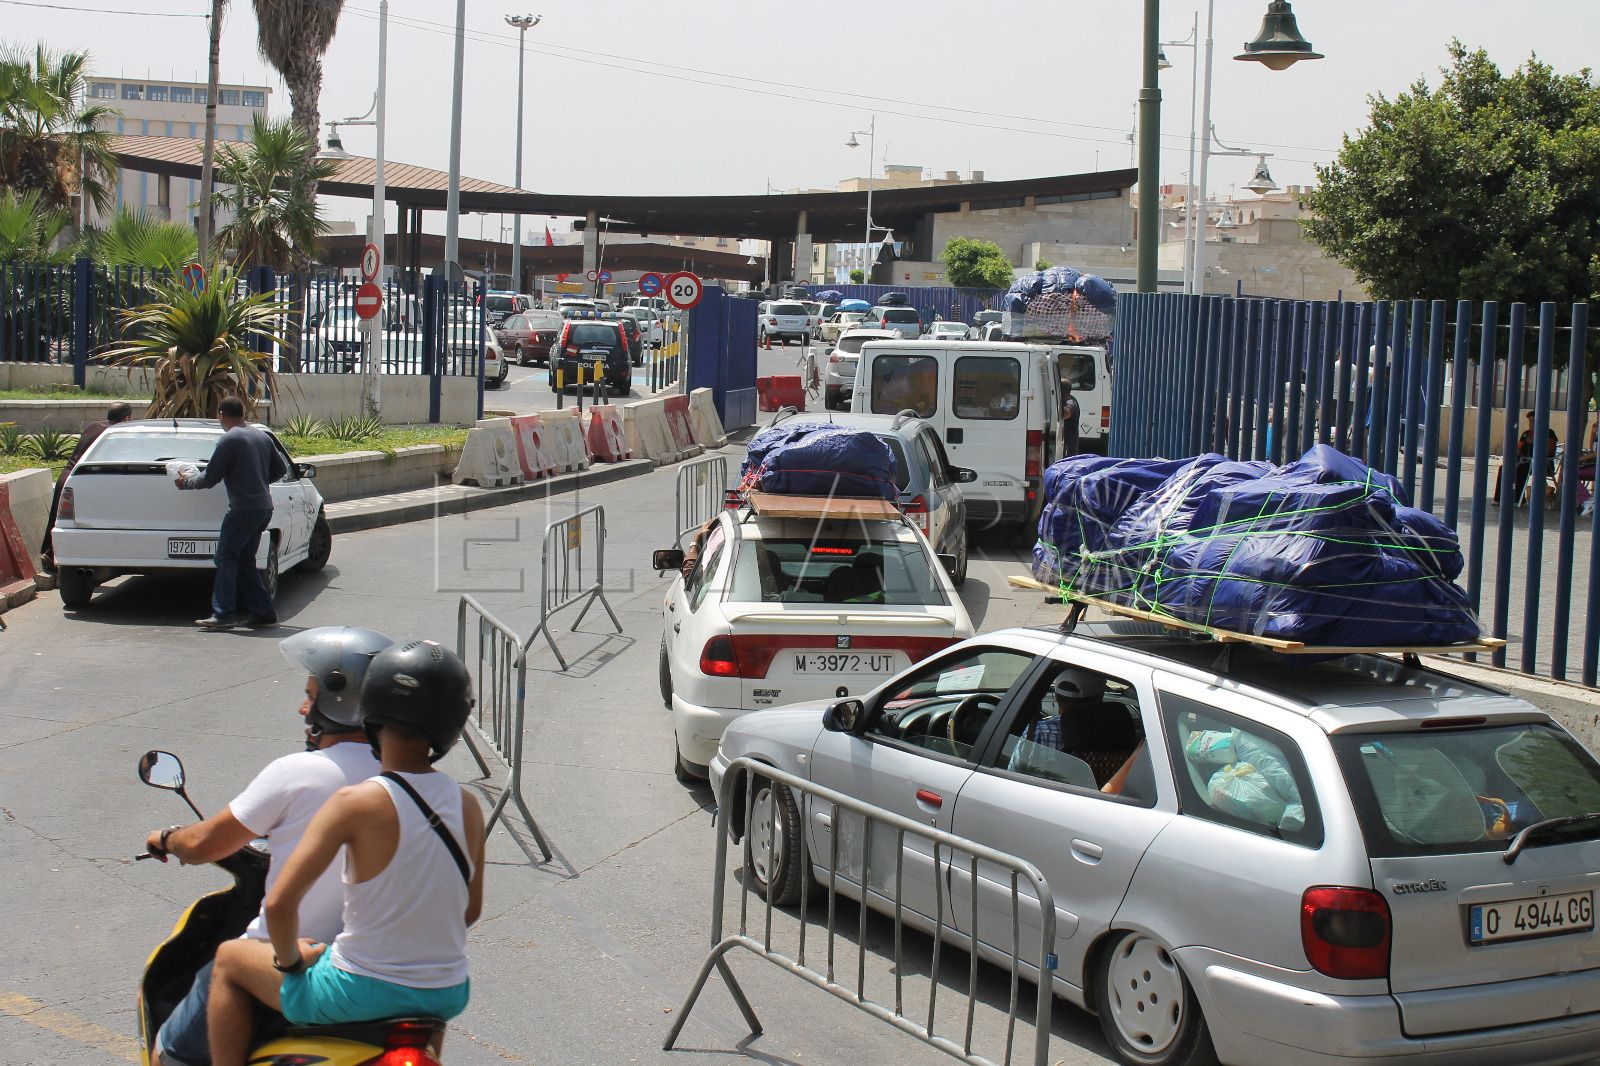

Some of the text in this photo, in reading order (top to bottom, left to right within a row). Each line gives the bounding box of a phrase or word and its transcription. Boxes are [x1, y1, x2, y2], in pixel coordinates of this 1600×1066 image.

[674, 284, 694, 297] 20
[577, 362, 610, 370] POLIIA
[169, 541, 196, 553] 19720
